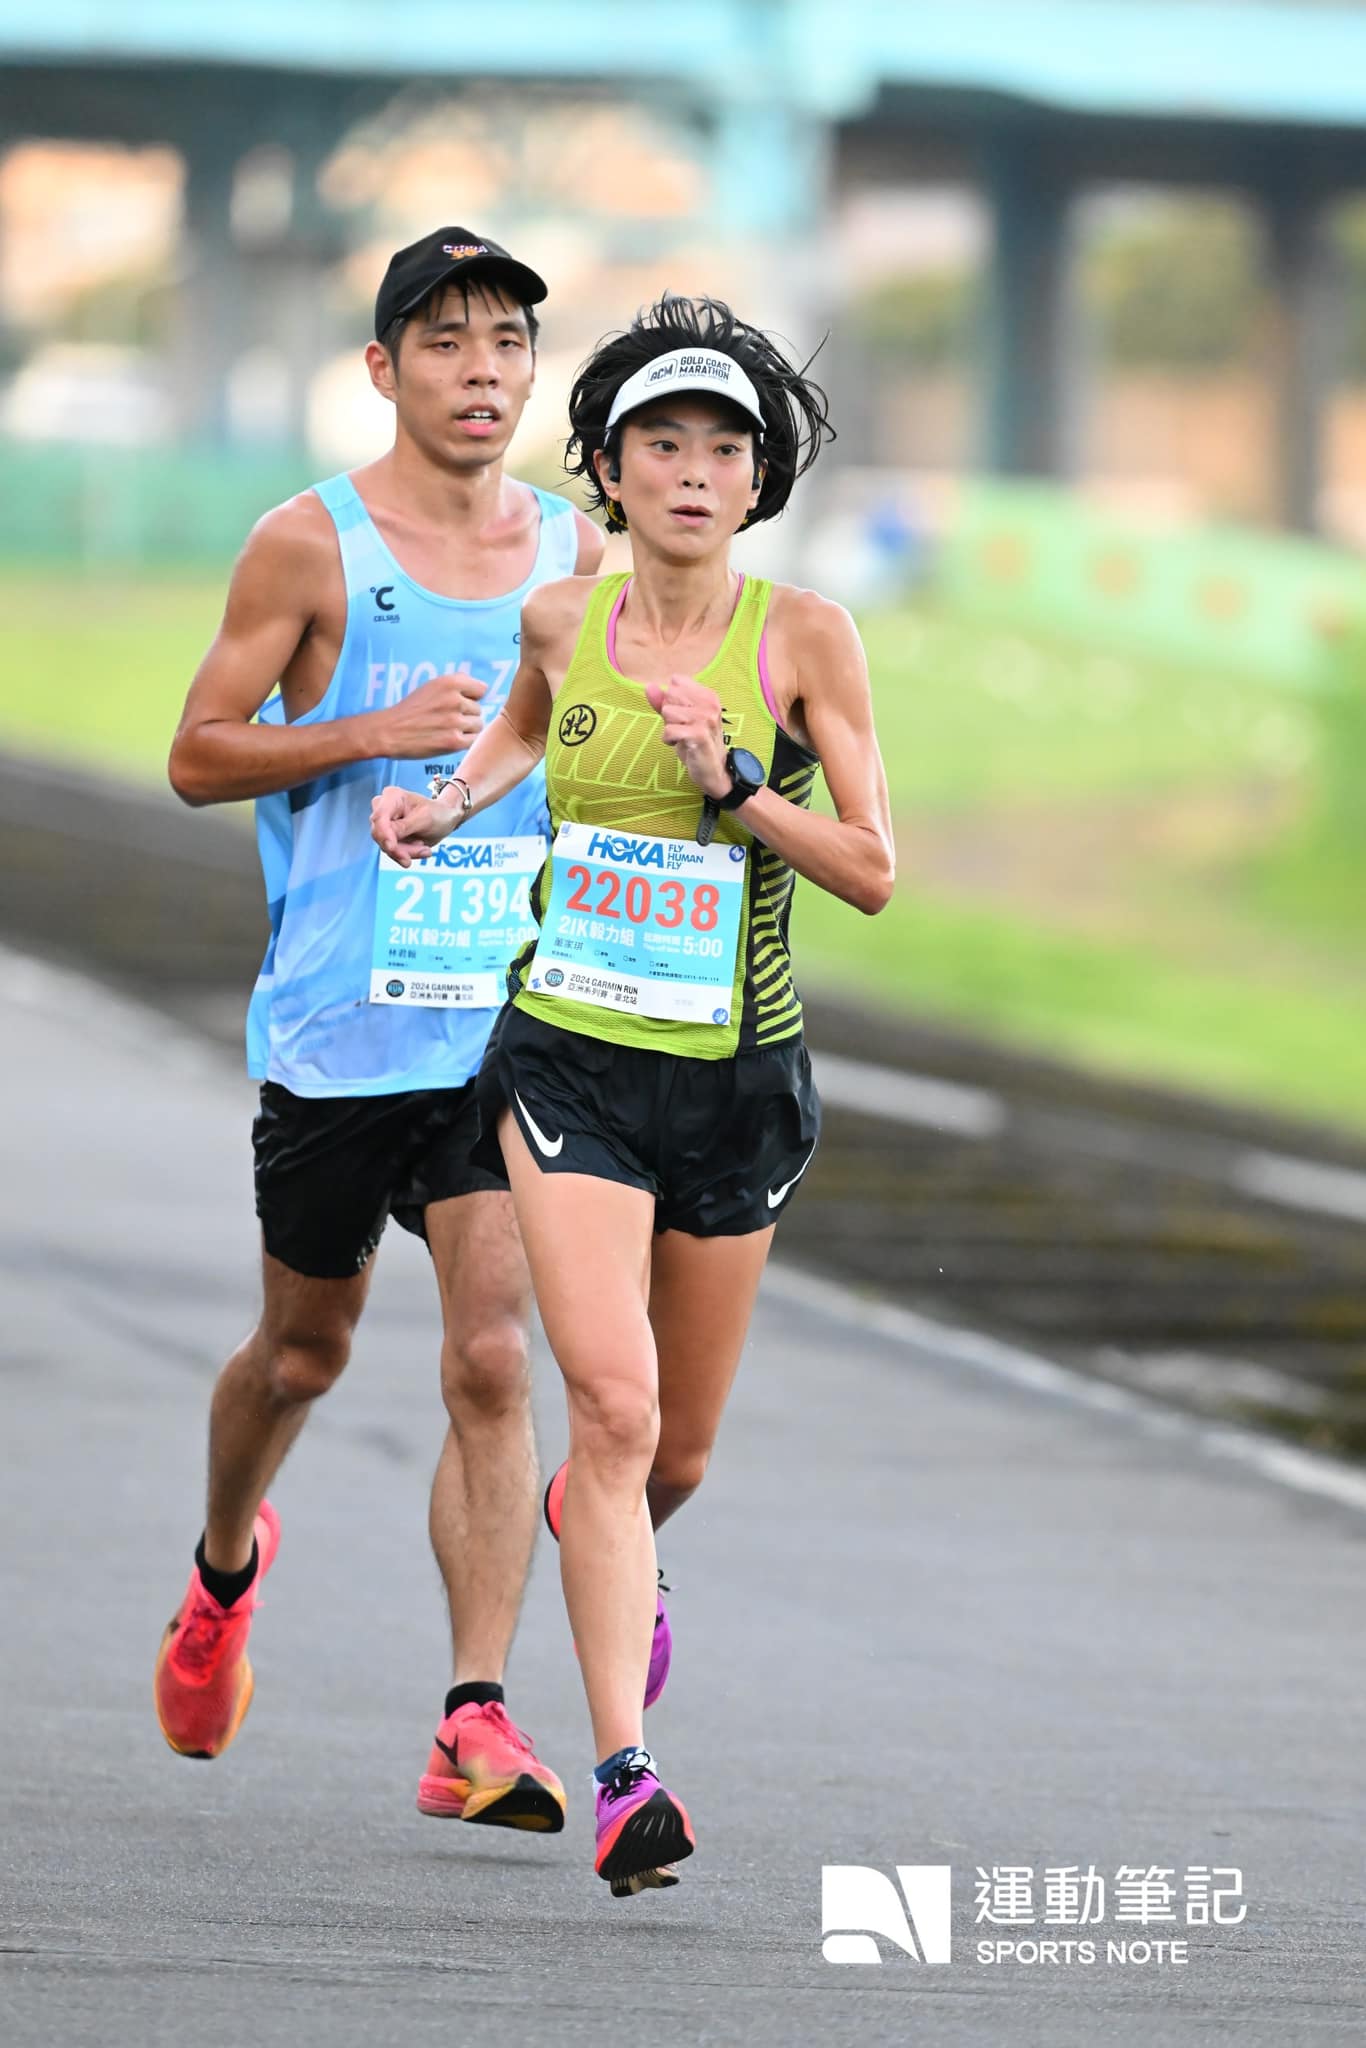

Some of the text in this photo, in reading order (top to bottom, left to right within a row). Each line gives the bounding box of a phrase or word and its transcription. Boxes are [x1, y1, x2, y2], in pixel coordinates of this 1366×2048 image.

[679, 365, 730, 381] MARATHON
[680, 356, 732, 373] GOLD COAST
[420, 844, 492, 868] HOKA
[587, 832, 664, 869] HOKA
[668, 843, 684, 852] FLY
[667, 852, 704, 863] HUMAN
[667, 861, 682, 870] FLY
[393, 875, 529, 924] 21394
[566, 865, 720, 932] 22038
[683, 935, 723, 958] 5:00
[411, 982, 430, 990] 2024
[431, 983, 460, 992] GARMIN
[570, 973, 638, 995] 2024 GARMIN RUN
